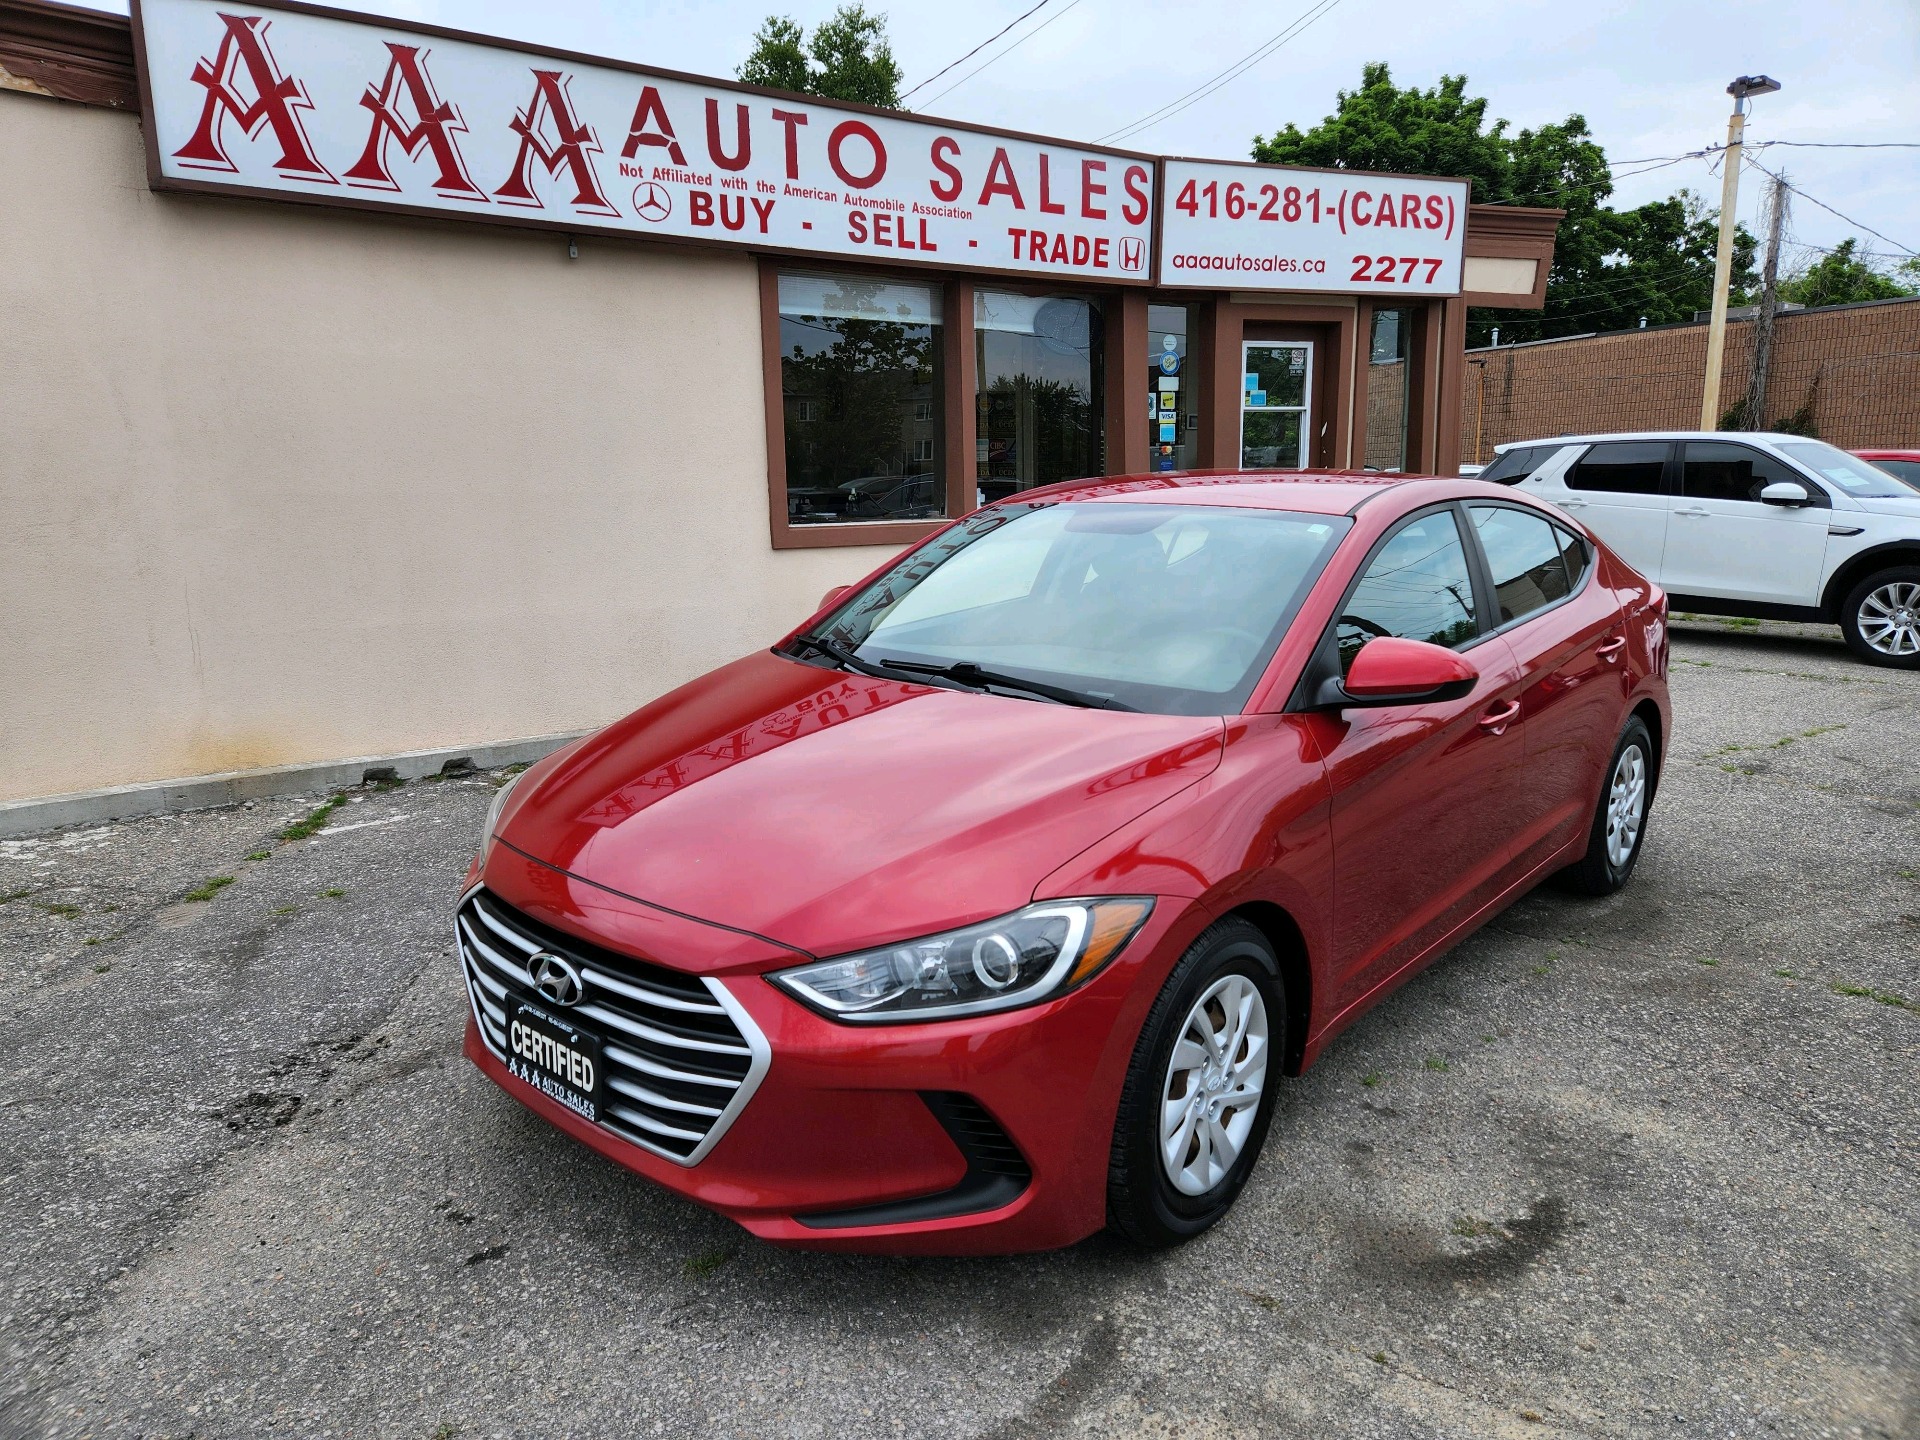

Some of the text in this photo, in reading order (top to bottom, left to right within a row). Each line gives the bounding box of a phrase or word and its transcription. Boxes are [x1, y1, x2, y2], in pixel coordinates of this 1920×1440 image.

[620, 85, 888, 190] AUTO
[929, 136, 1149, 225] SALES
[619, 163, 973, 220] Not Affiliated with the American Automobile Association
[1175, 178, 1455, 241] 416-281-(CARS)
[689, 190, 775, 234] BUY
[848, 210, 938, 251] SELL
[1008, 227, 1110, 268] TRADE
[1172, 253, 1443, 284] aaaautosales.ca 2277
[989, 441, 1007, 451] CIBC
[511, 1020, 594, 1093] CERTIFIED
[542, 1076, 564, 1098] AUTO
[567, 1090, 595, 1116] SALES
